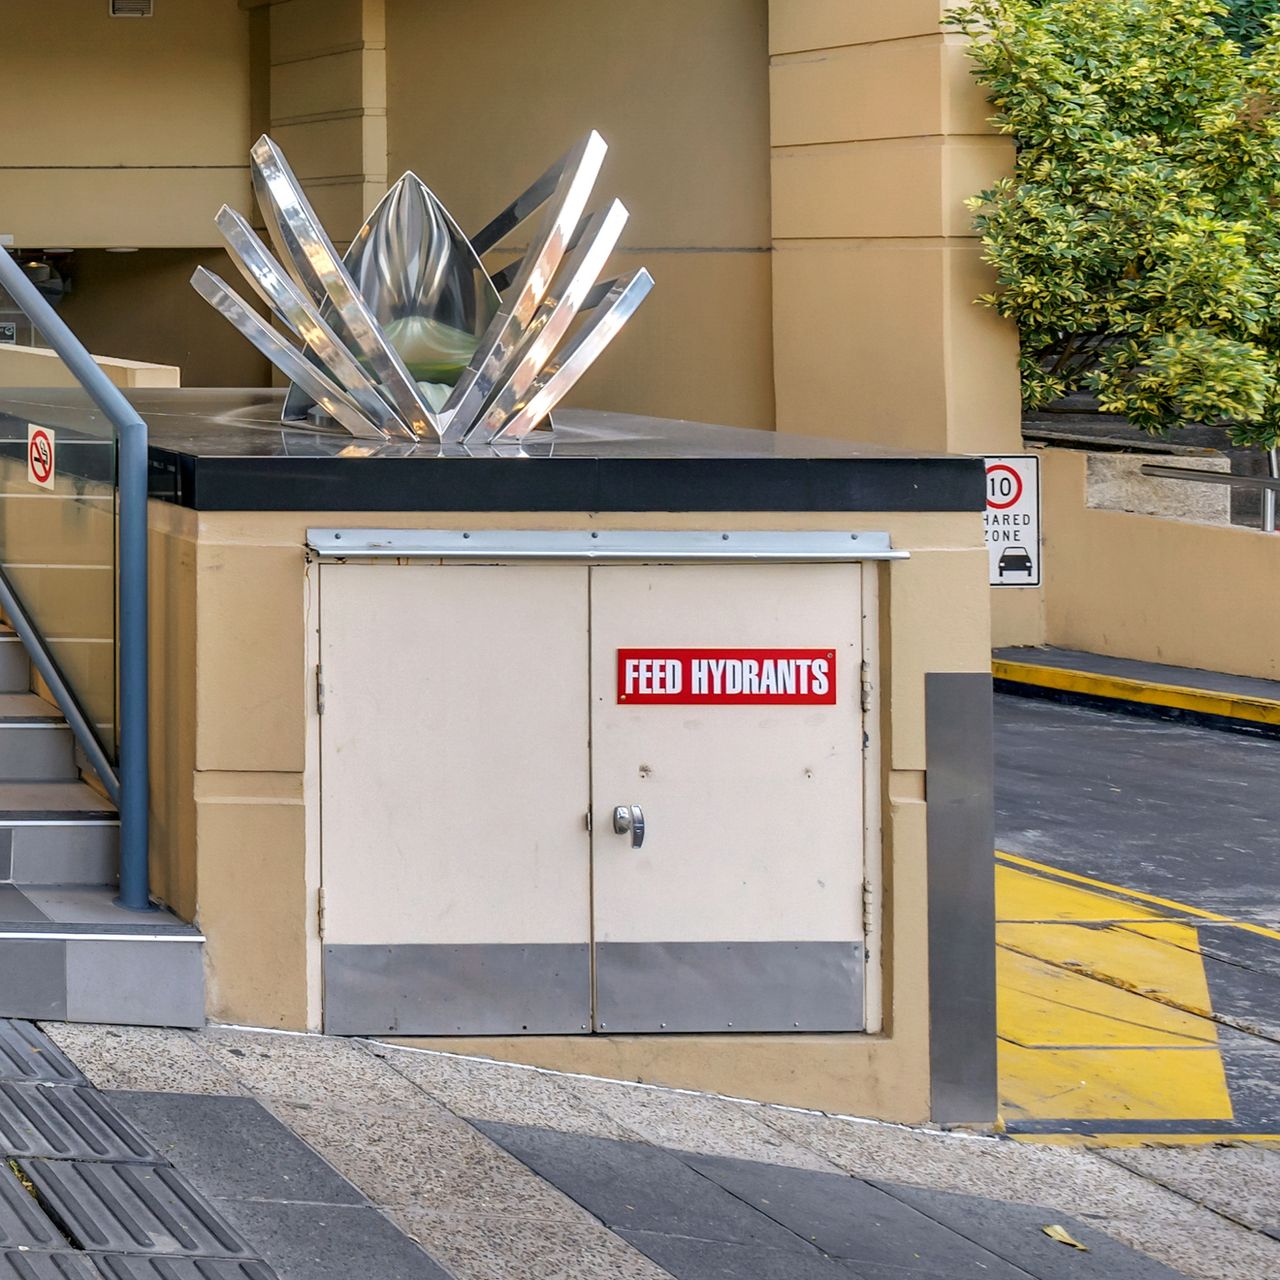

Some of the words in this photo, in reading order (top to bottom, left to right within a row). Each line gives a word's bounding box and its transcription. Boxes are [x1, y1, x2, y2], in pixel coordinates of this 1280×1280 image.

[990, 477, 1011, 497] 10
[625, 659, 682, 695] FEED
[691, 659, 829, 695] HYDRANTS
